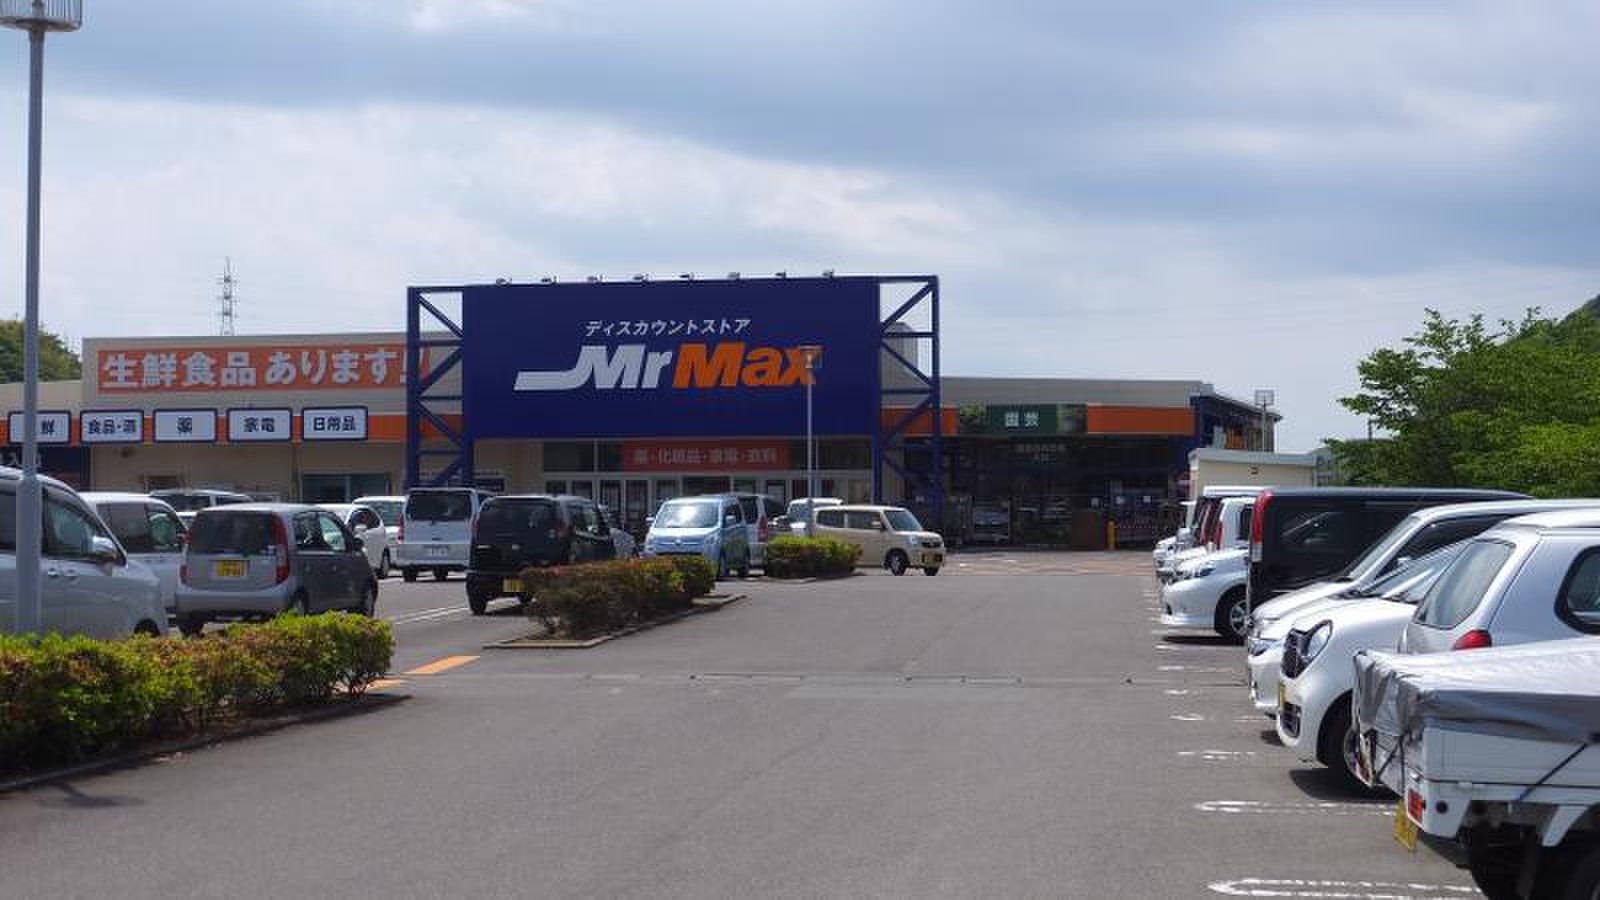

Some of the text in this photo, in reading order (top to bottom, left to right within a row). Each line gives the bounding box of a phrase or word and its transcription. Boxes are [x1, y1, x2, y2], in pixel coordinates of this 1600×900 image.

[585, 319, 752, 337] ディスカウントストア
[102, 351, 257, 388] 生鮮食品
[513, 342, 820, 391] Mr Max
[312, 415, 356, 431] 日用品
